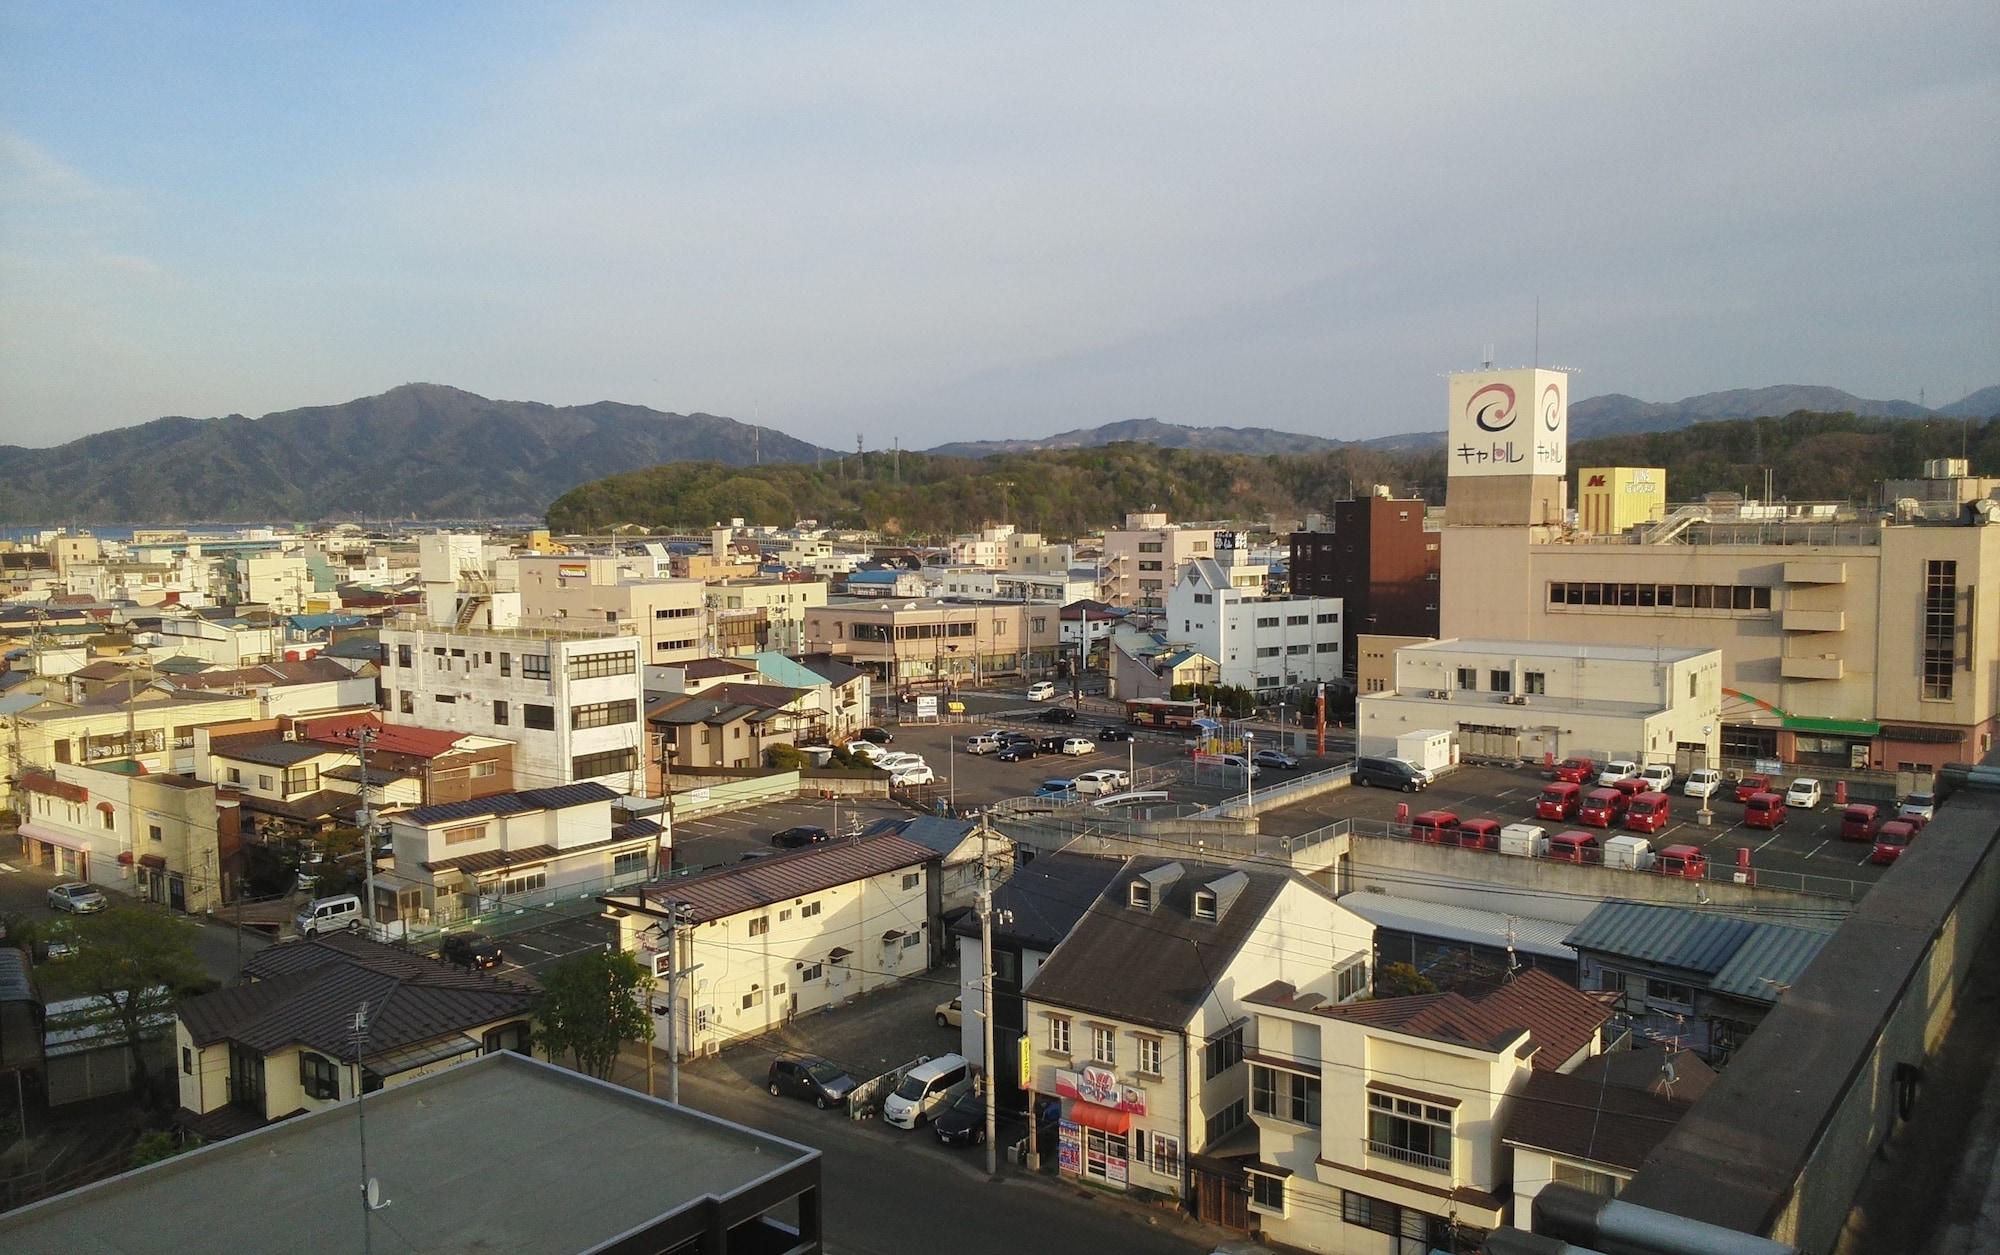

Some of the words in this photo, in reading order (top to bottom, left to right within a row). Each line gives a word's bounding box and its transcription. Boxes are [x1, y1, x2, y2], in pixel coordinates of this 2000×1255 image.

[1457, 442, 1524, 464] キャトル
[1537, 440, 1562, 463] キャトル
